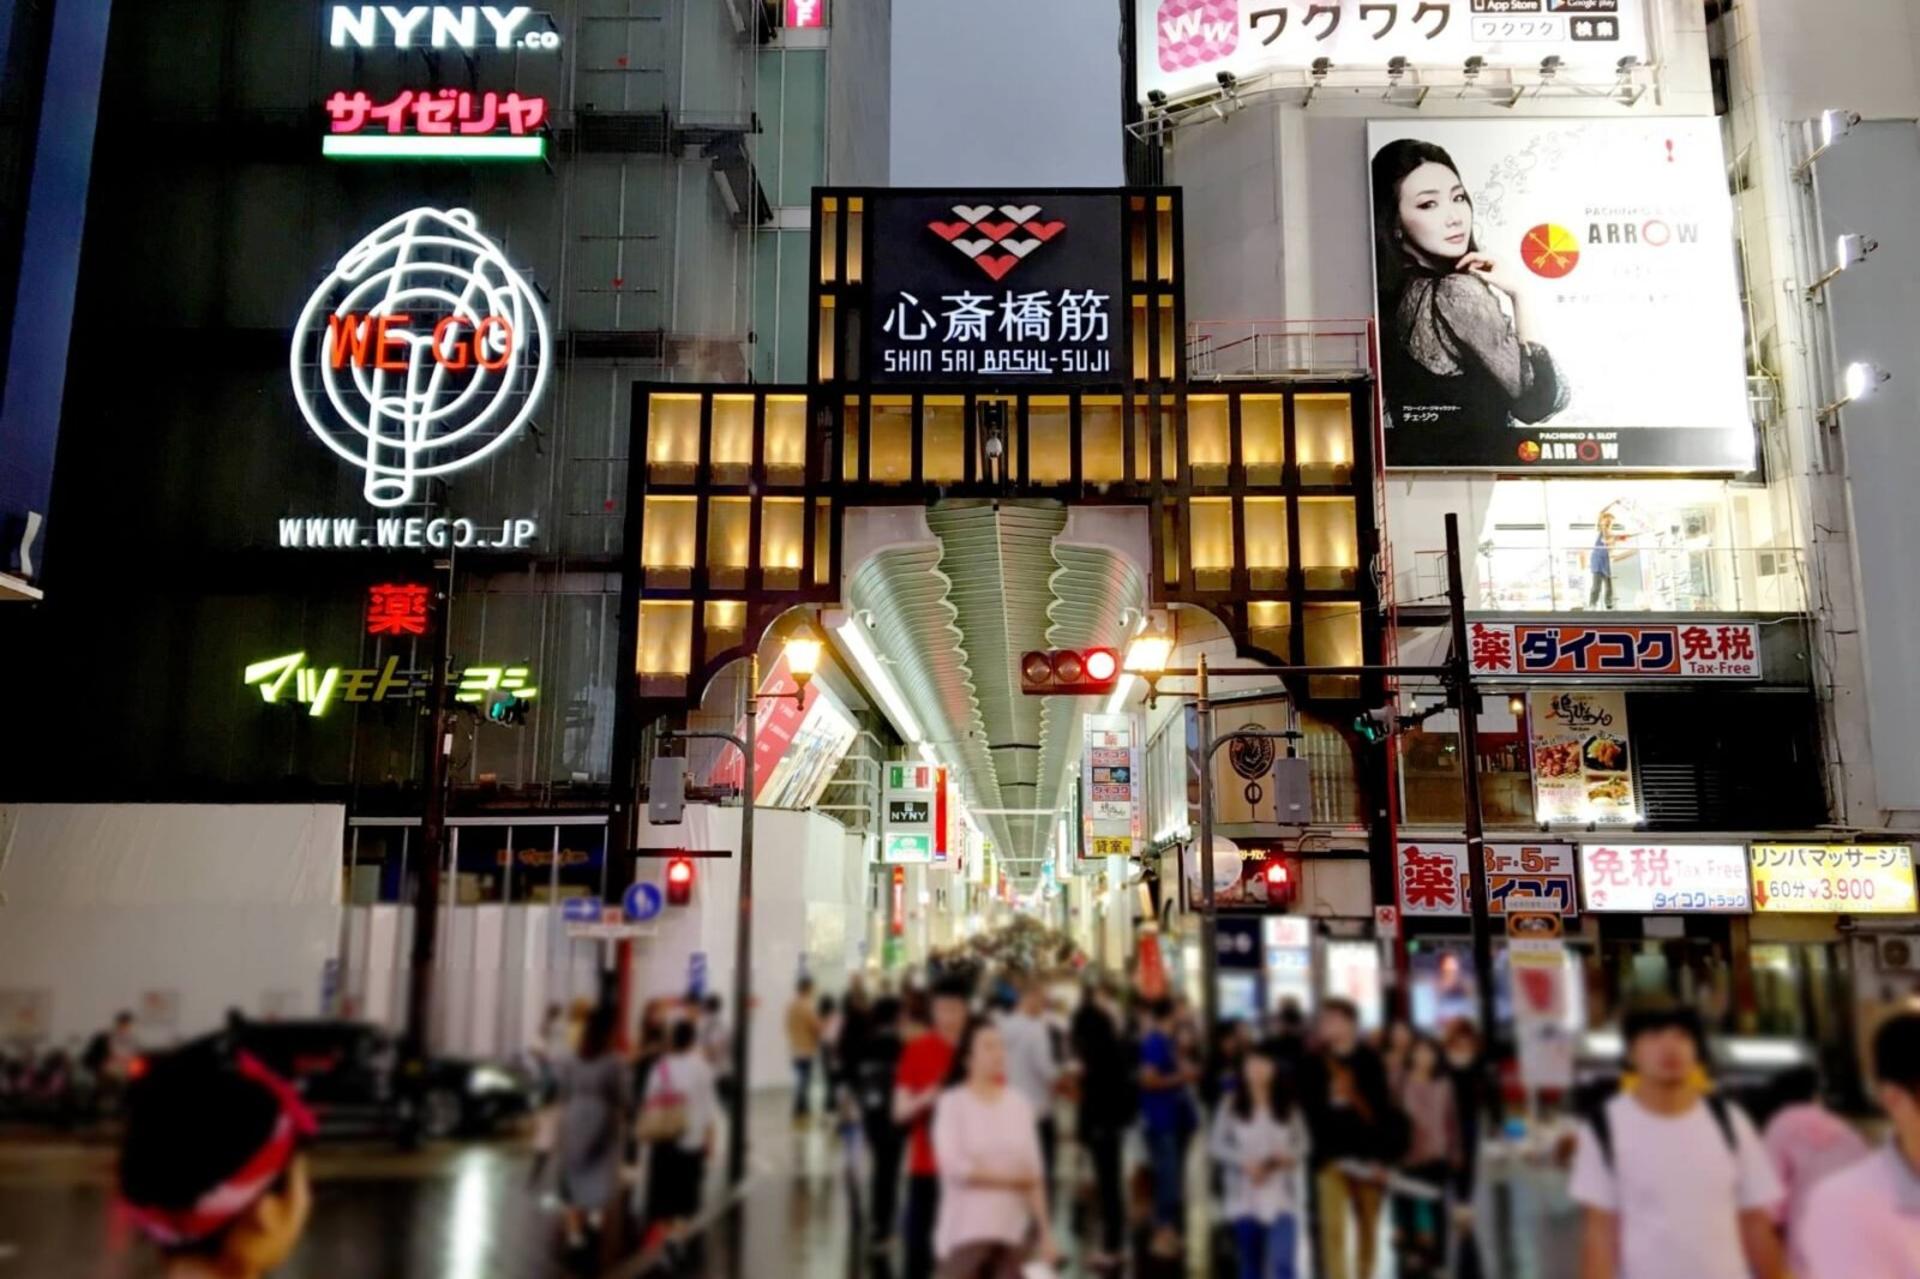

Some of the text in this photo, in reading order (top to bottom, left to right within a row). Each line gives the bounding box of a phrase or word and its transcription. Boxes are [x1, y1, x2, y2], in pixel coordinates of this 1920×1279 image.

[1250, 2, 1450, 46] ワクワク
[1482, 21, 1554, 36] ワクワク
[325, 89, 546, 135] サイゼリヤ
[1588, 219, 1699, 247] ARROW
[883, 289, 1110, 343] 心斎橋筋
[885, 350, 931, 371] SHIN
[1541, 440, 1619, 461] ARROW
[279, 517, 536, 549] WWW.WEGO.JP
[366, 583, 429, 636] 薬
[1472, 622, 1754, 671] 薬 ダイコク 免税
[1690, 662, 1751, 675] Tax-Free
[892, 811, 926, 820] NYNY
[1403, 846, 1455, 907] 薬
[1588, 847, 1673, 887] 免税
[1770, 880, 1805, 898] 60分
